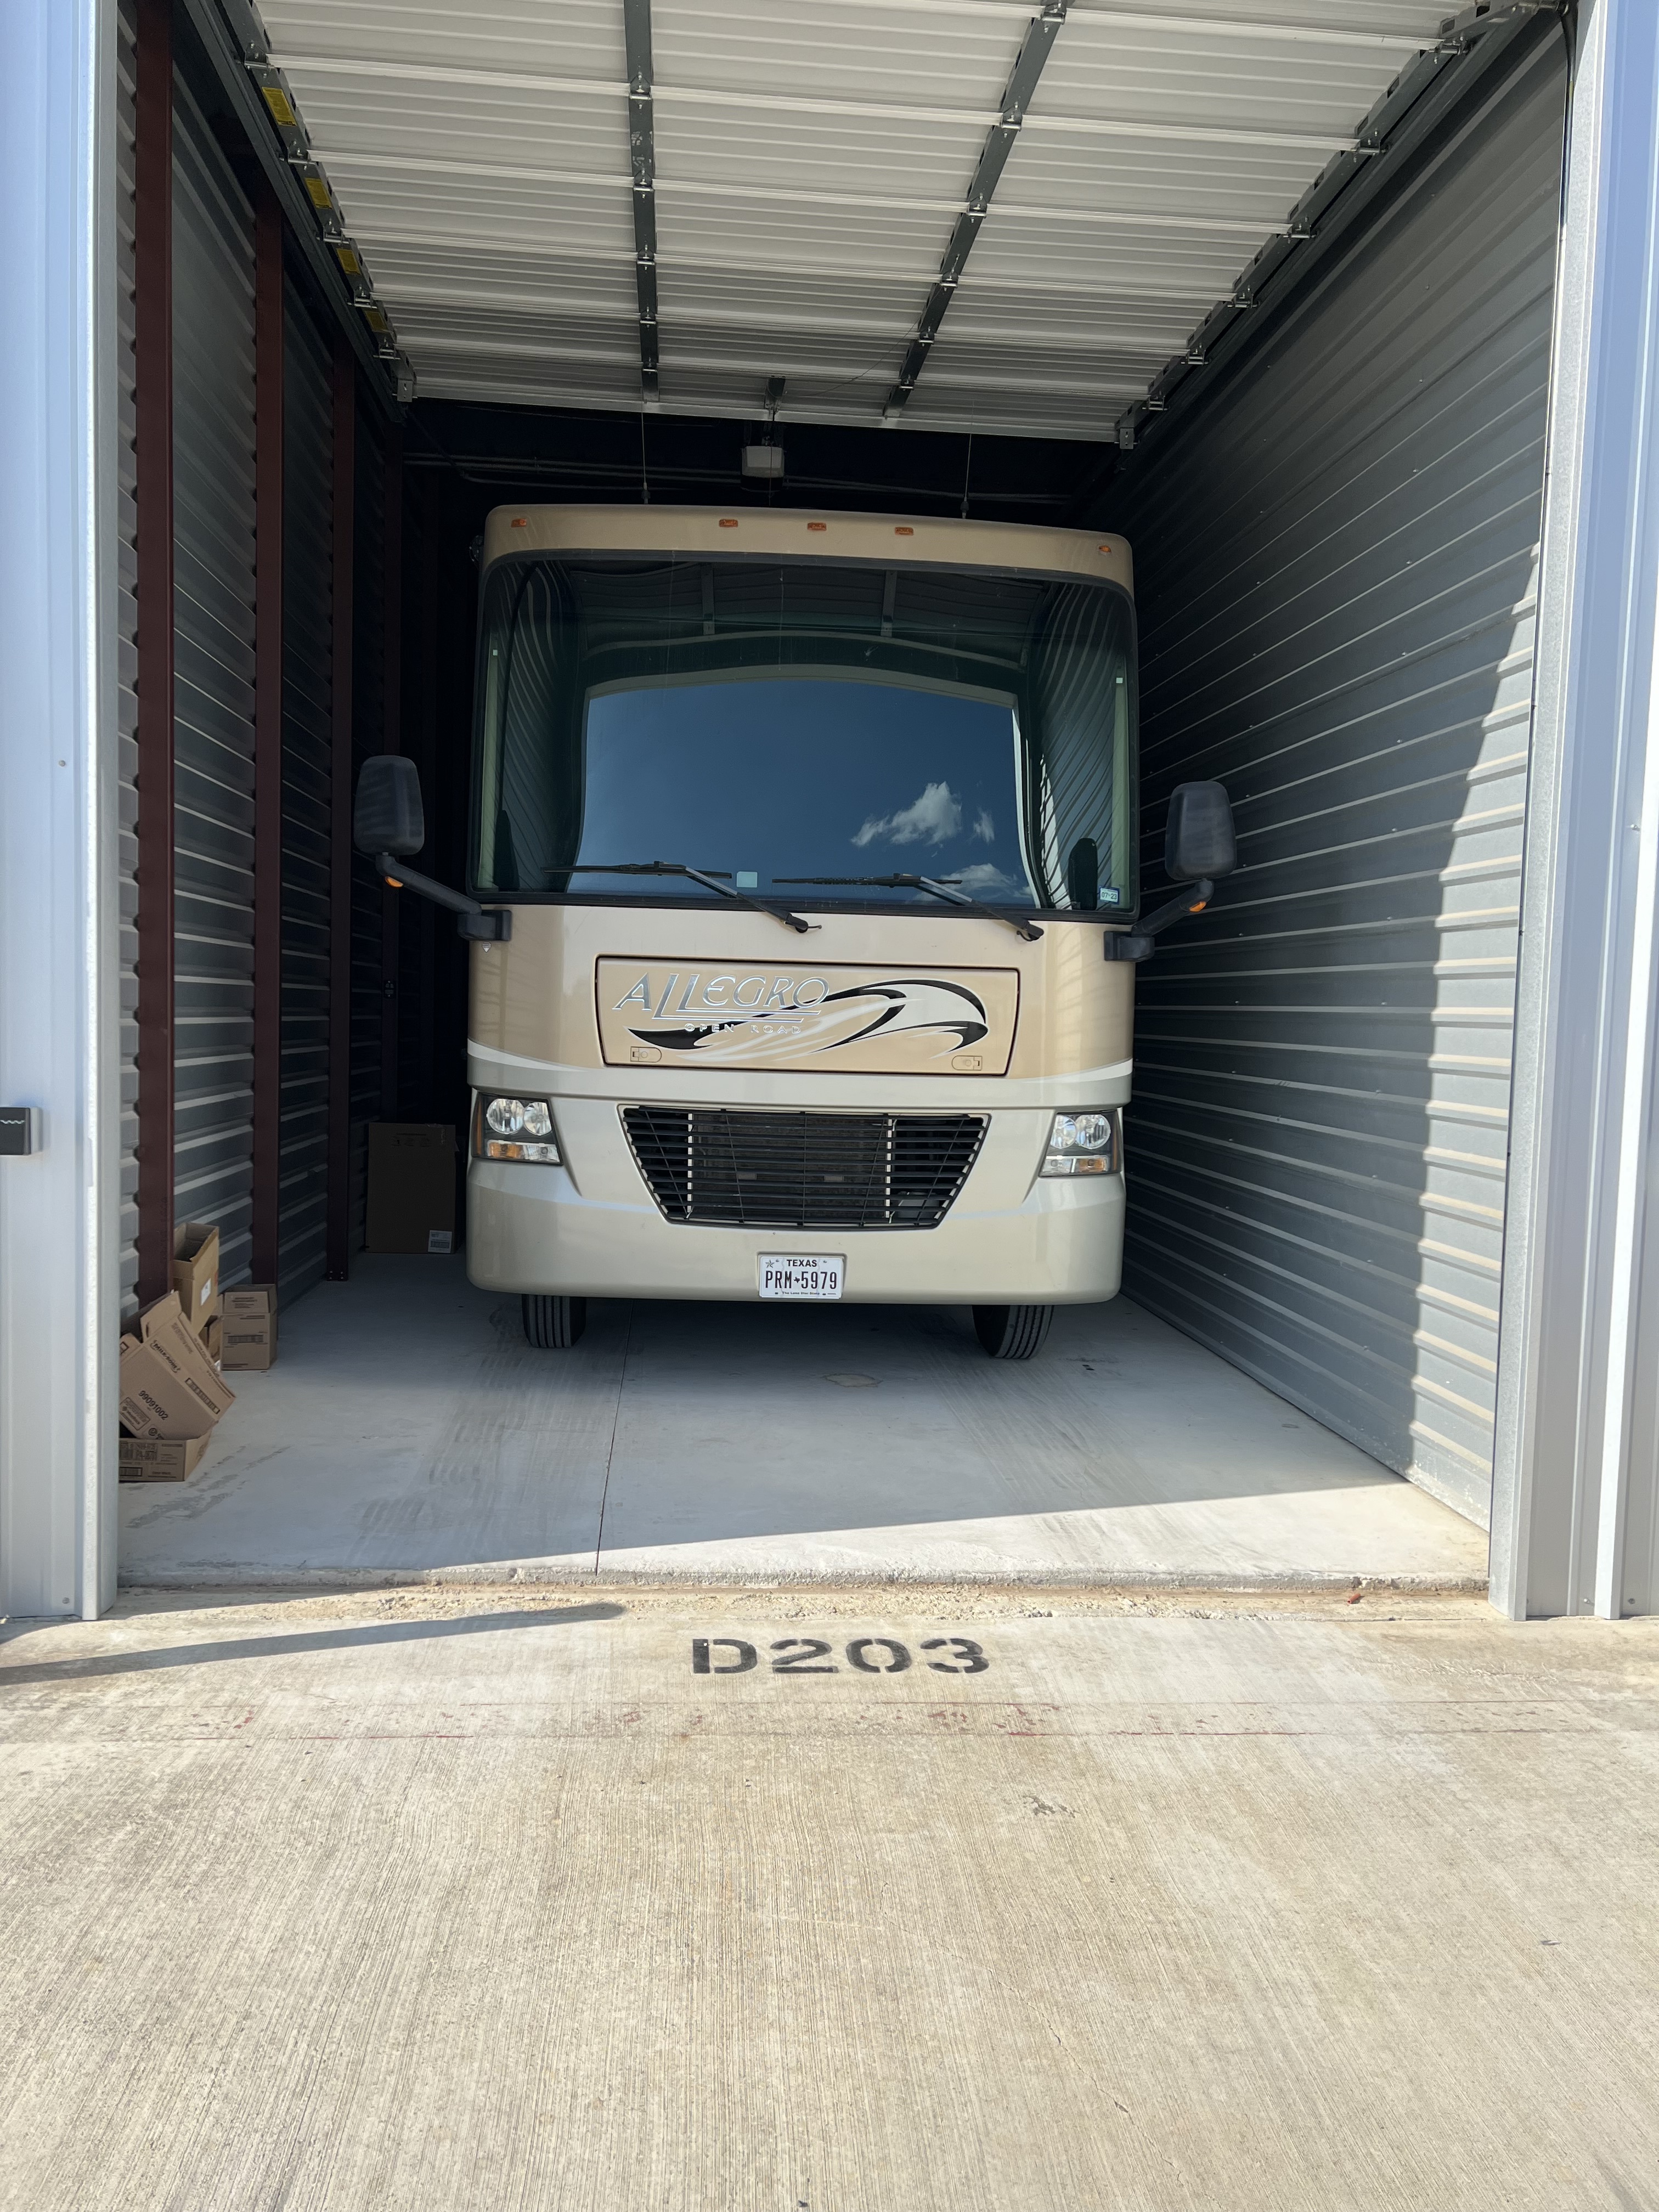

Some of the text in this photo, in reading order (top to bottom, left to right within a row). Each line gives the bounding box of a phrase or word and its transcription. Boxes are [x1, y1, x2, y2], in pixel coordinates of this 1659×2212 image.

[612, 972, 830, 1021] ALLEGRO
[685, 1023, 801, 1034] OPEN ROAD
[138, 1390, 168, 1420] 99091002
[692, 1638, 990, 1674] D203
